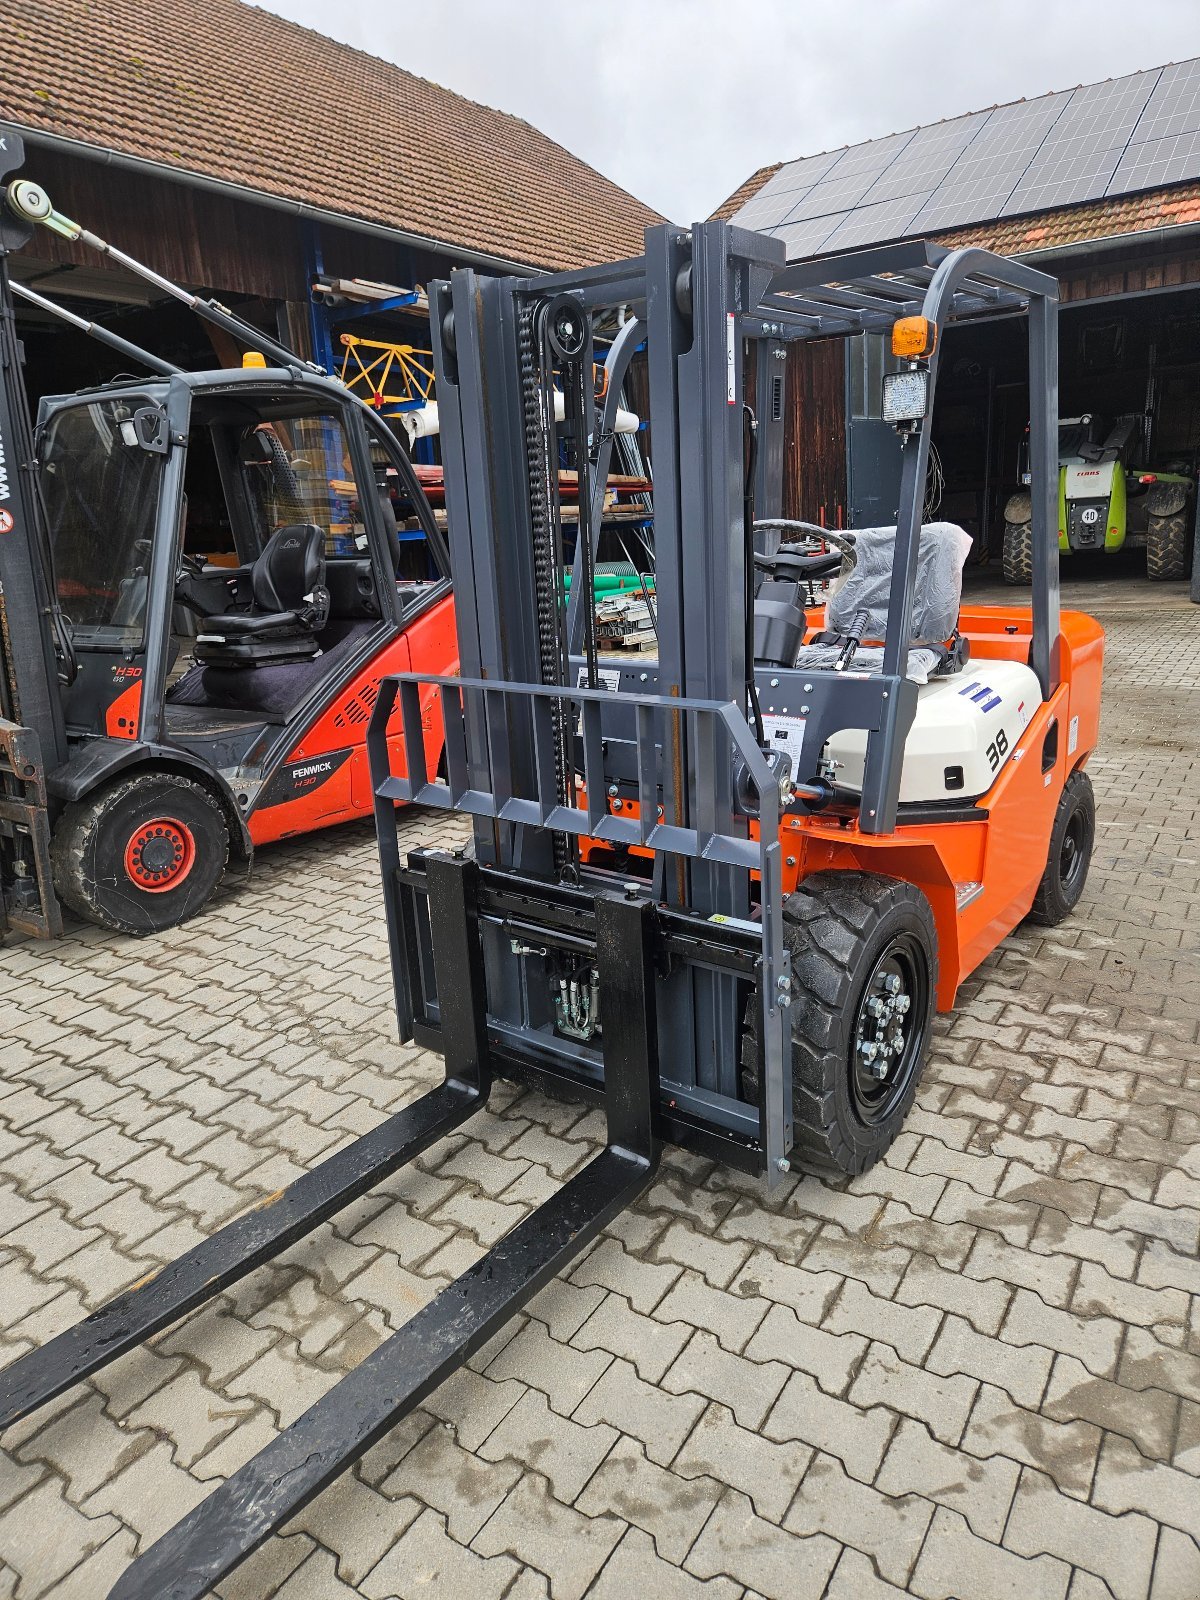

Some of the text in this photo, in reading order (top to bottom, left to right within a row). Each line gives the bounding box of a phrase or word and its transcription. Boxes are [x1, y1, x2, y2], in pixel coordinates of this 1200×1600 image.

[1084, 511, 1096, 521] 40
[115, 667, 143, 677] H30
[985, 728, 1009, 773] 38
[292, 762, 332, 779] FENWICK
[294, 777, 317, 789] H30
